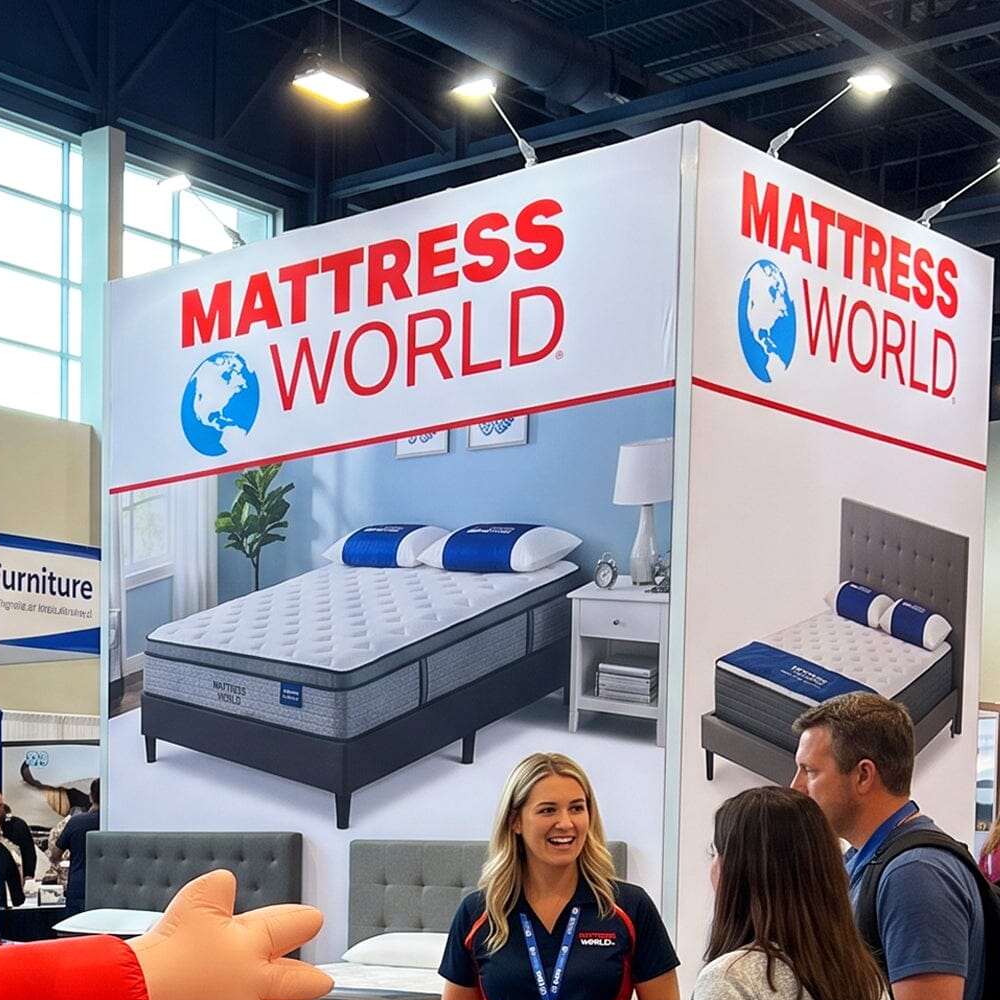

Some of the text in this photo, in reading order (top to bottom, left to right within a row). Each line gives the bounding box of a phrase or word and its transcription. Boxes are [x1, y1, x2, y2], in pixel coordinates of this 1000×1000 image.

[180, 198, 565, 347] MATTRESS
[741, 170, 958, 320] MATTRESS
[802, 279, 958, 399] WORLD
